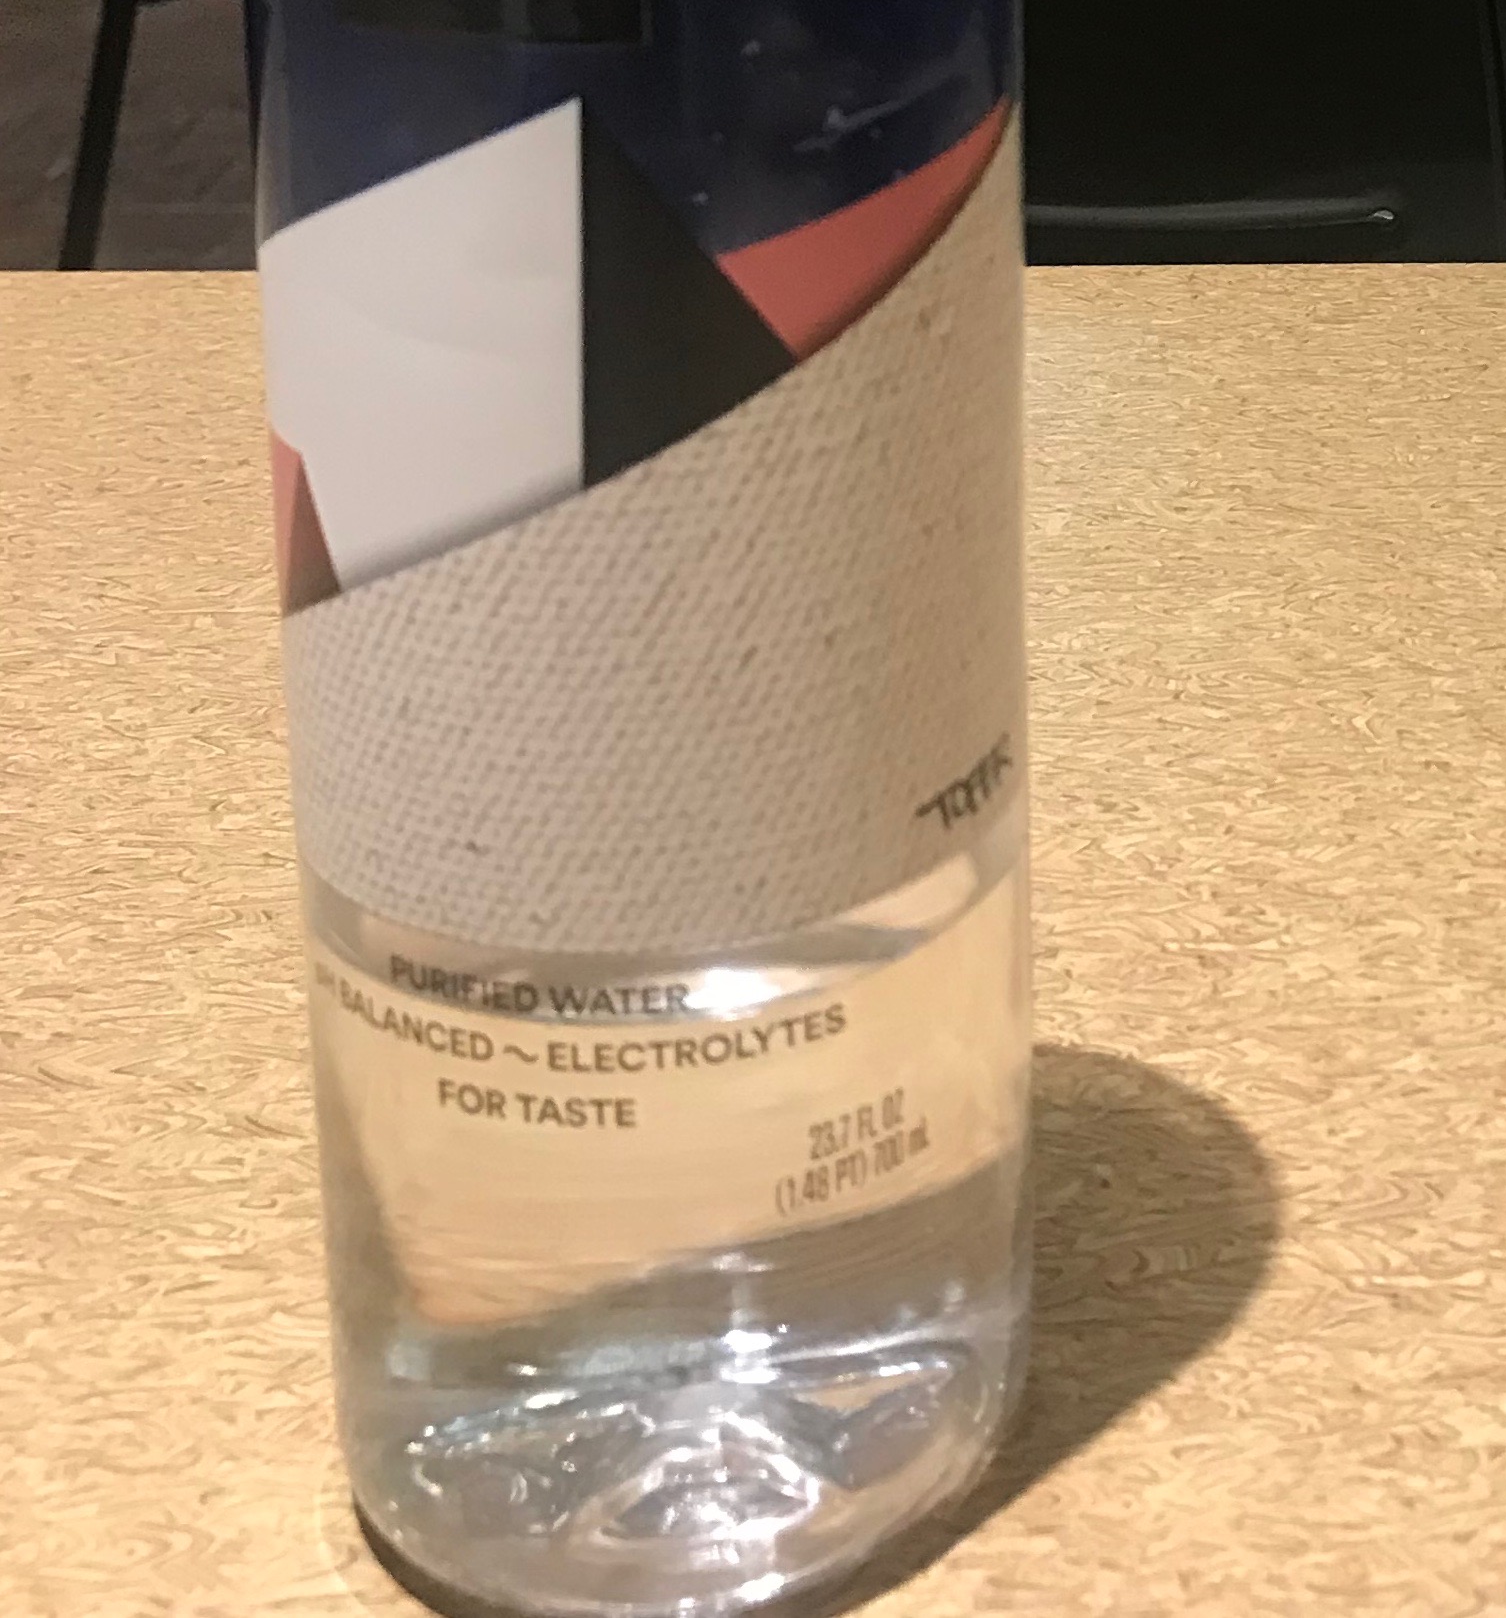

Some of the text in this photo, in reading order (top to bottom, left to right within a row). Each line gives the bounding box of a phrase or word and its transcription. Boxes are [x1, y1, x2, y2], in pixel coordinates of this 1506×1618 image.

[389, 953, 692, 1016] PURIFIED WATER
[339, 977, 495, 1062] BALANCED
[547, 1002, 848, 1074] ELECTROLYTES
[437, 1078, 637, 1129] FOR TASTE
